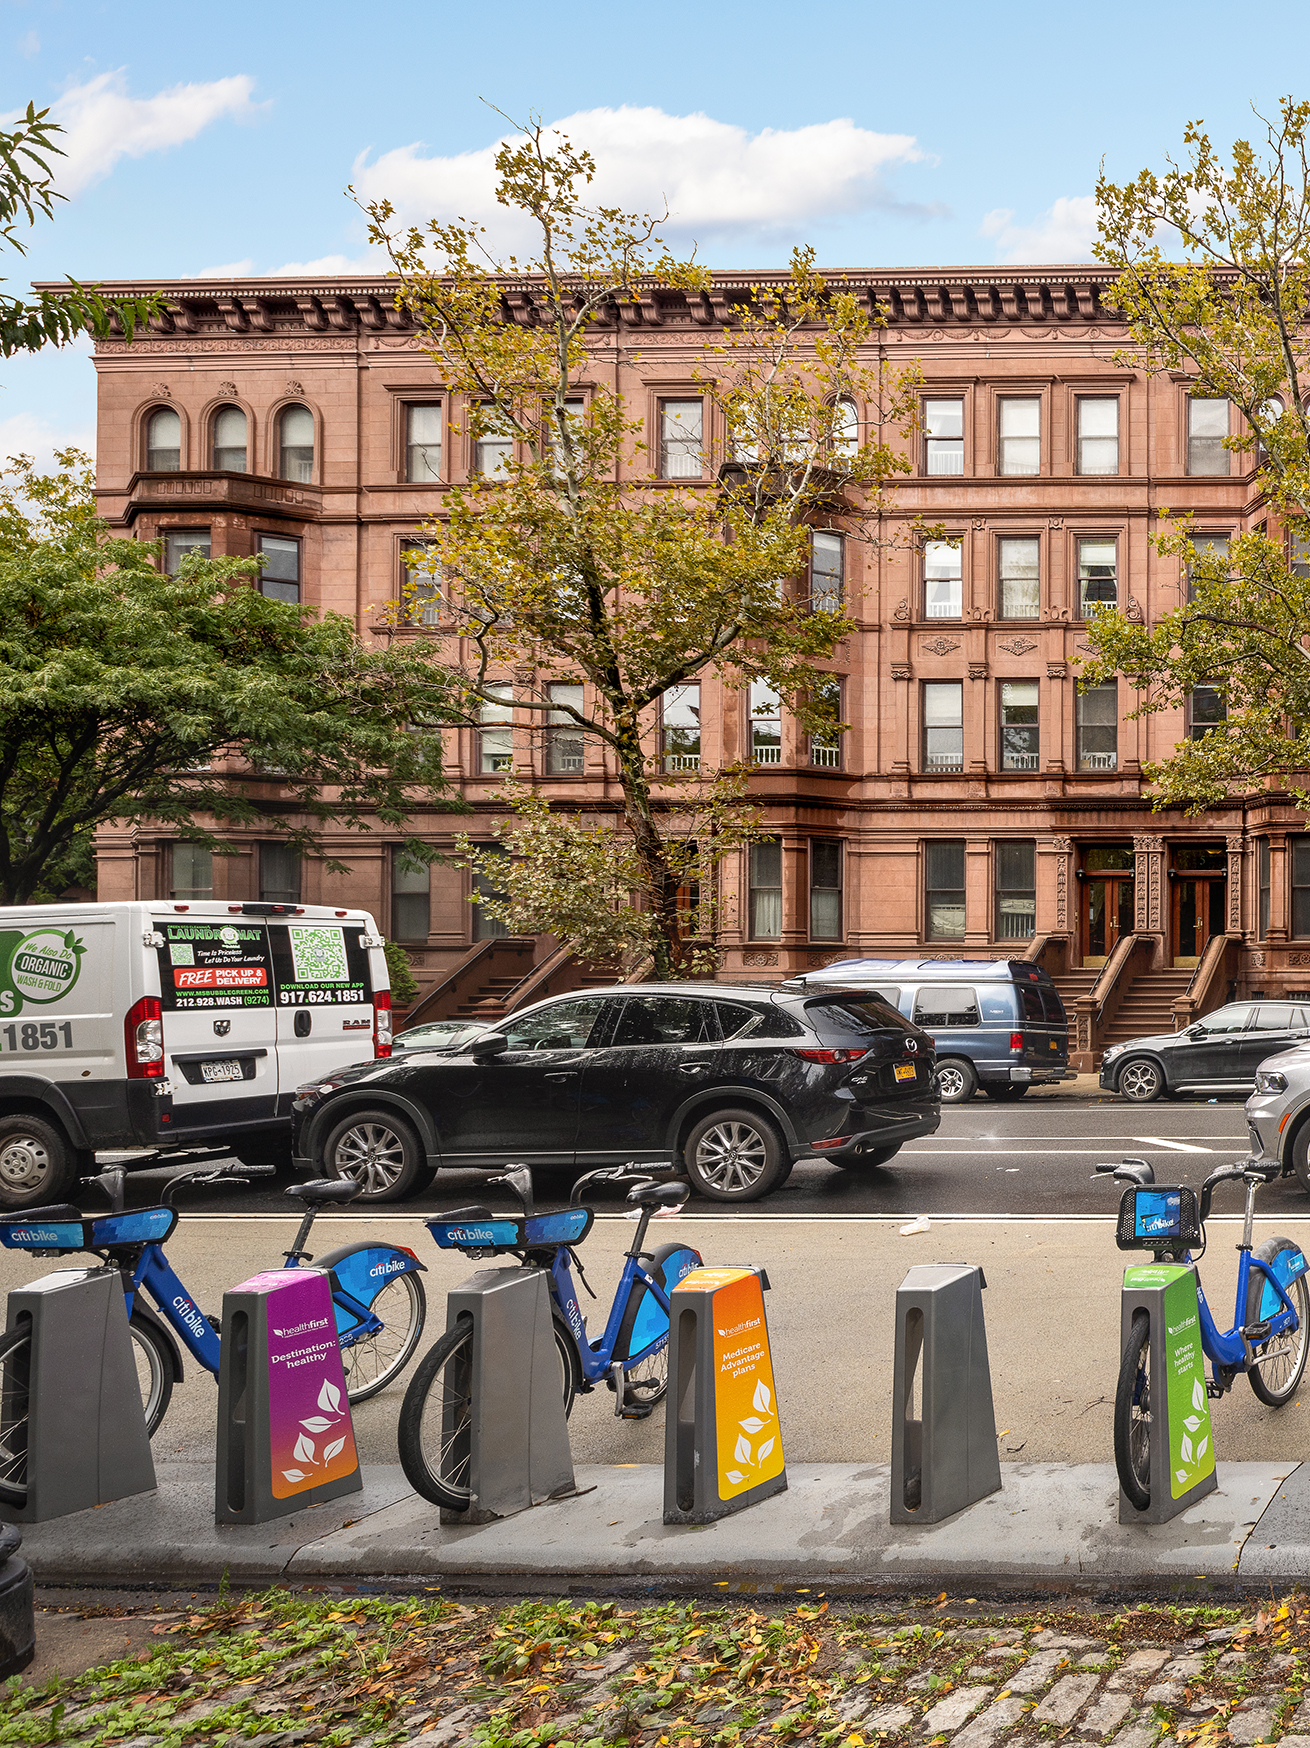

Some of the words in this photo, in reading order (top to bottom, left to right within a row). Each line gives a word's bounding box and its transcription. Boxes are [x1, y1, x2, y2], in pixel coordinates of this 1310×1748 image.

[1107, 854, 1114, 864] 4
[1200, 856, 1206, 866] 5
[24, 943, 38, 953] We
[38, 946, 58, 957] Also
[60, 949, 72, 960] Do
[20, 955, 68, 978] ORGANIC
[16, 974, 37, 988] WASH
[38, 978, 45, 989] &
[45, 980, 62, 992] FOLD
[179, 969, 213, 986] FREE
[255, 969, 263, 977] &
[216, 977, 261, 985] DELIVERY
[176, 997, 243, 1007] 212.928.WASH
[244, 995, 270, 1006] (9274)
[280, 989, 364, 1004] 917.624.1851
[11, 1229, 31, 1241] citi
[31, 1230, 58, 1241] bike
[447, 1228, 466, 1240] citi
[467, 1229, 494, 1240] bike
[370, 1262, 385, 1277] citi
[386, 1260, 405, 1274] bike
[173, 1296, 191, 1317] citi
[184, 1310, 205, 1338] bike
[566, 1299, 577, 1319] citi
[283, 1317, 329, 1336] healthfirst
[571, 1312, 582, 1340] bike
[725, 1318, 761, 1336] healthfirst
[271, 1340, 336, 1364] Destination:
[722, 1343, 761, 1362] Medicare
[1174, 1343, 1193, 1357] Where
[1174, 1350, 1195, 1367] healthy
[286, 1352, 327, 1369] healthy
[720, 1350, 765, 1372] Advantage
[1177, 1361, 1194, 1375] starts
[732, 1363, 756, 1378] plans
